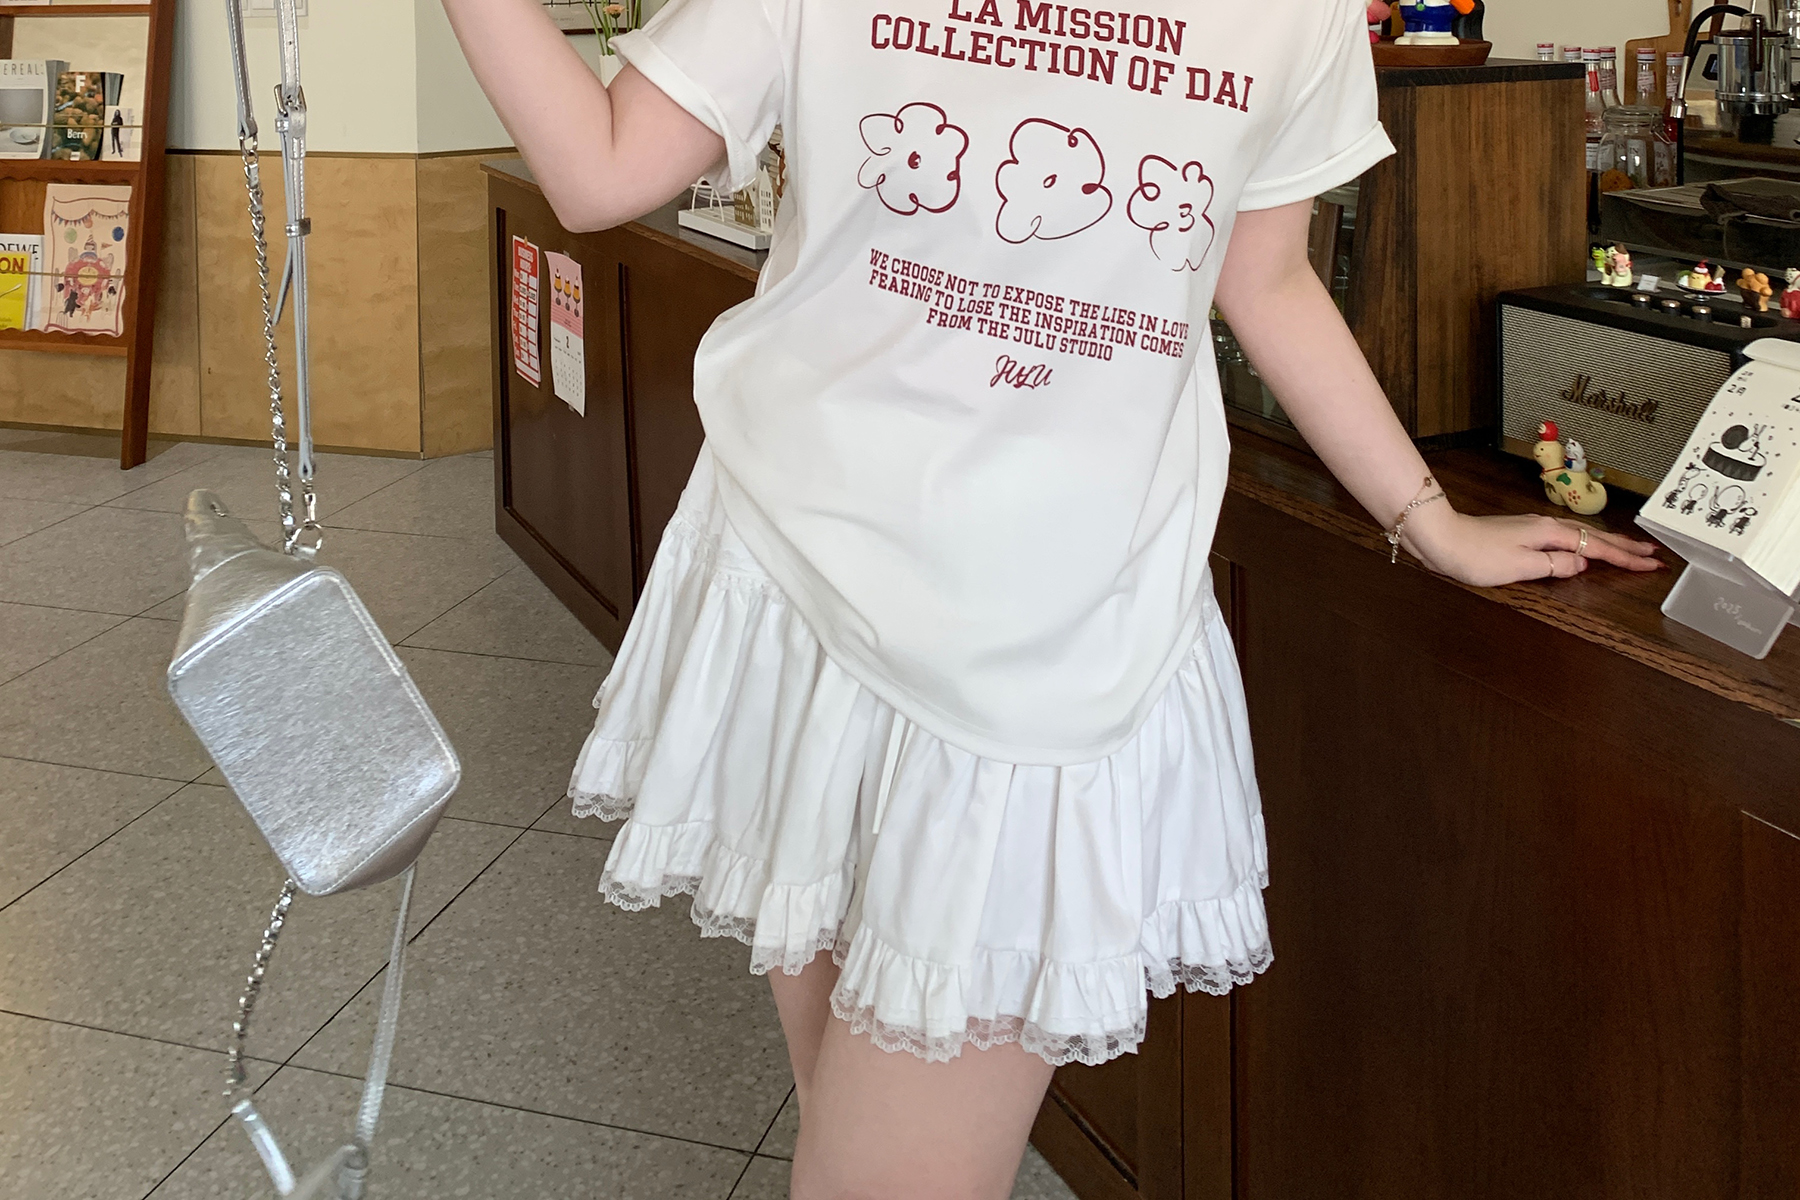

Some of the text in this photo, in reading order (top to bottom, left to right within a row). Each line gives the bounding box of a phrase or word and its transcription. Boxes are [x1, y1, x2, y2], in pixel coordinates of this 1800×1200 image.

[871, 14, 1254, 113] COLLECTION OF DAI
[869, 248, 1189, 340] WE CHOOSE NOT TO EXPOSE THE LIES IN LOVE
[869, 269, 1185, 358] FEARING TO LOSE THE INSPIRATION COMES
[926, 307, 1114, 362] FROM THE JULU STUDIO
[1561, 374, 1659, 423] Marshall
